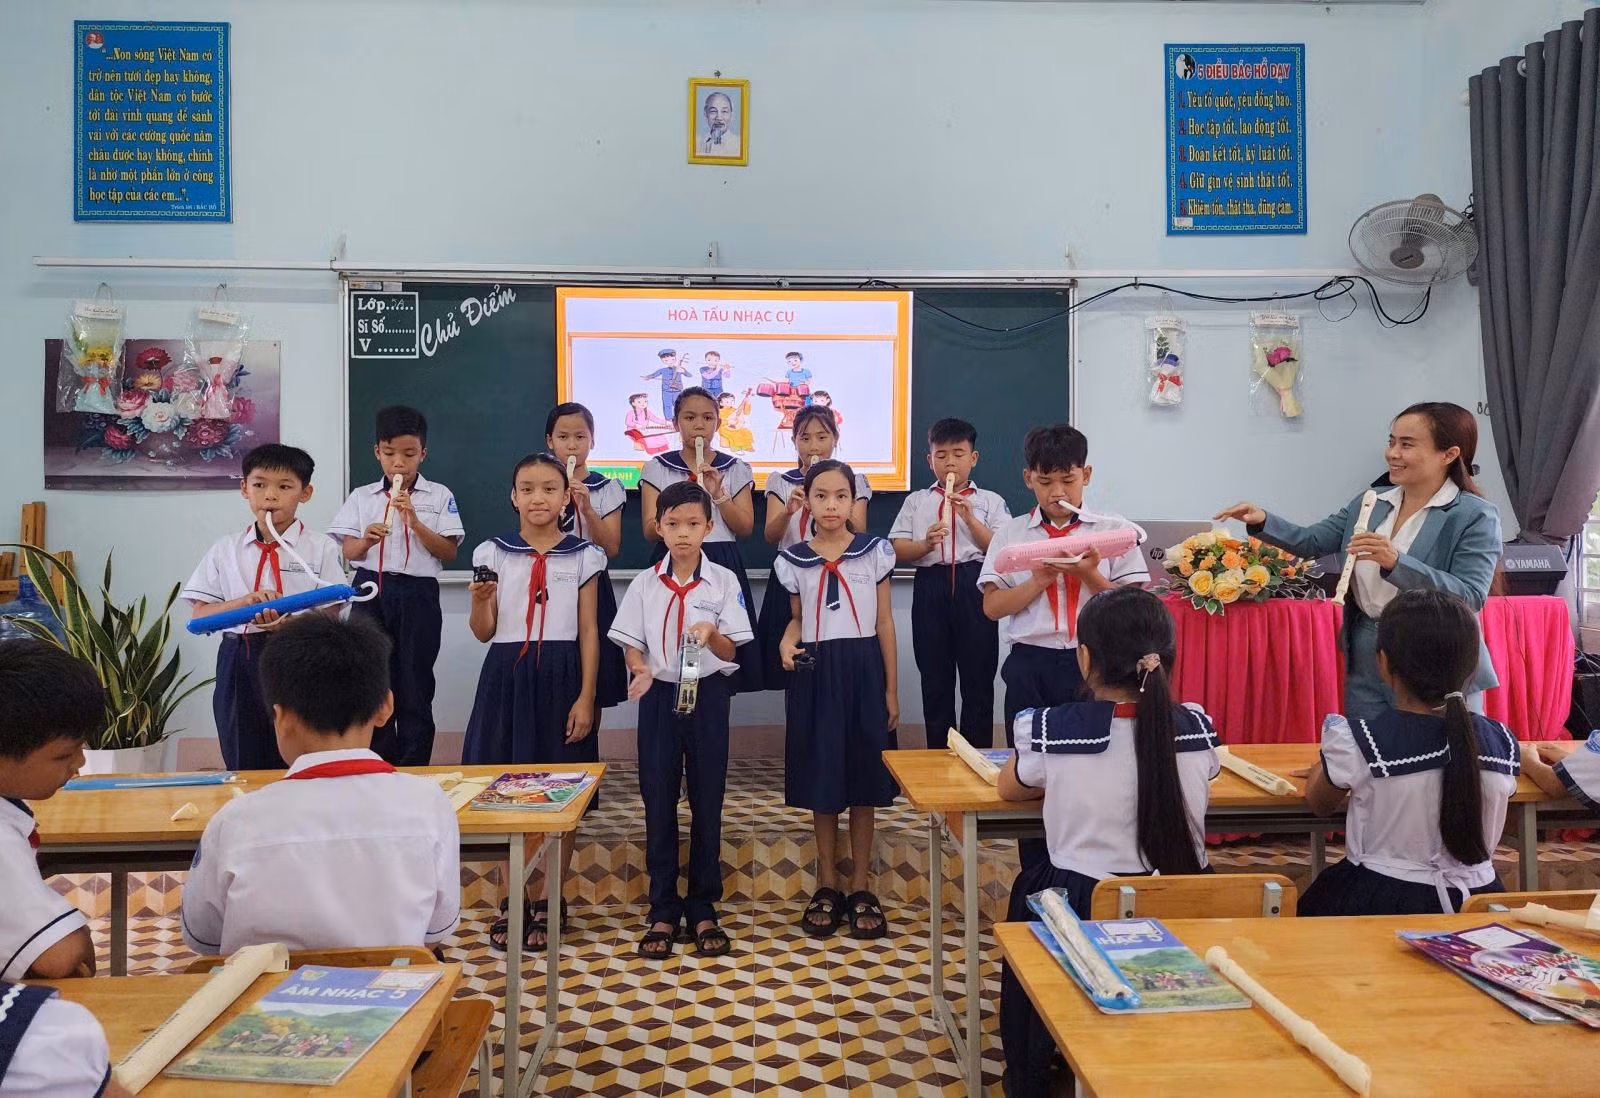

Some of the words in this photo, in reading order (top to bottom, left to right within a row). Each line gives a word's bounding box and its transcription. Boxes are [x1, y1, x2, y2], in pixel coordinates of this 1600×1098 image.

[135, 48, 154, 63] sông
[158, 48, 176, 62] Việt
[180, 48, 198, 60] Nam
[203, 49, 212, 60] có
[105, 70, 121, 82] nên
[124, 70, 142, 82] tươi
[164, 70, 180, 85] hay
[183, 70, 213, 85] không,
[1198, 65, 1205, 79] 5
[1232, 60, 1251, 79] BÁC
[1270, 64, 1290, 83] DẠY
[89, 89, 105, 101] dân
[110, 90, 124, 103] tộc
[128, 89, 146, 103] Việt
[151, 90, 171, 101] Nam
[177, 90, 187, 101] có
[191, 90, 213, 102] bước
[1238, 91, 1252, 111] yêu
[123, 109, 142, 121] vinh
[146, 111, 173, 124] quang
[89, 129, 101, 141] vai
[122, 129, 136, 141] các
[170, 127, 190, 144] quốc
[1188, 118, 1205, 138] Học
[1207, 119, 1220, 138] tập
[1240, 117, 1252, 134] lao
[89, 149, 110, 161] châu
[137, 149, 153, 163] hay
[156, 149, 186, 164] không,
[188, 149, 213, 162] chính
[1188, 145, 1210, 161] Đoàn
[89, 169, 97, 181] là
[120, 169, 138, 182] một
[193, 170, 214, 184] công
[1237, 171, 1255, 188] sinh
[90, 188, 106, 204] học
[108, 188, 122, 204] tập
[144, 188, 159, 201] các
[421, 312, 461, 357] Chủ
[460, 284, 517, 326] Điểm
[668, 306, 698, 321] HOÀ
[702, 305, 728, 322] TẤU
[733, 310, 771, 325] NHẠC
[776, 310, 794, 325] CỤ
[1515, 559, 1552, 569] YAMAHA
[279, 983, 321, 998] ÂM
[320, 987, 386, 1000] NHẠC
[389, 988, 407, 1000] 5
